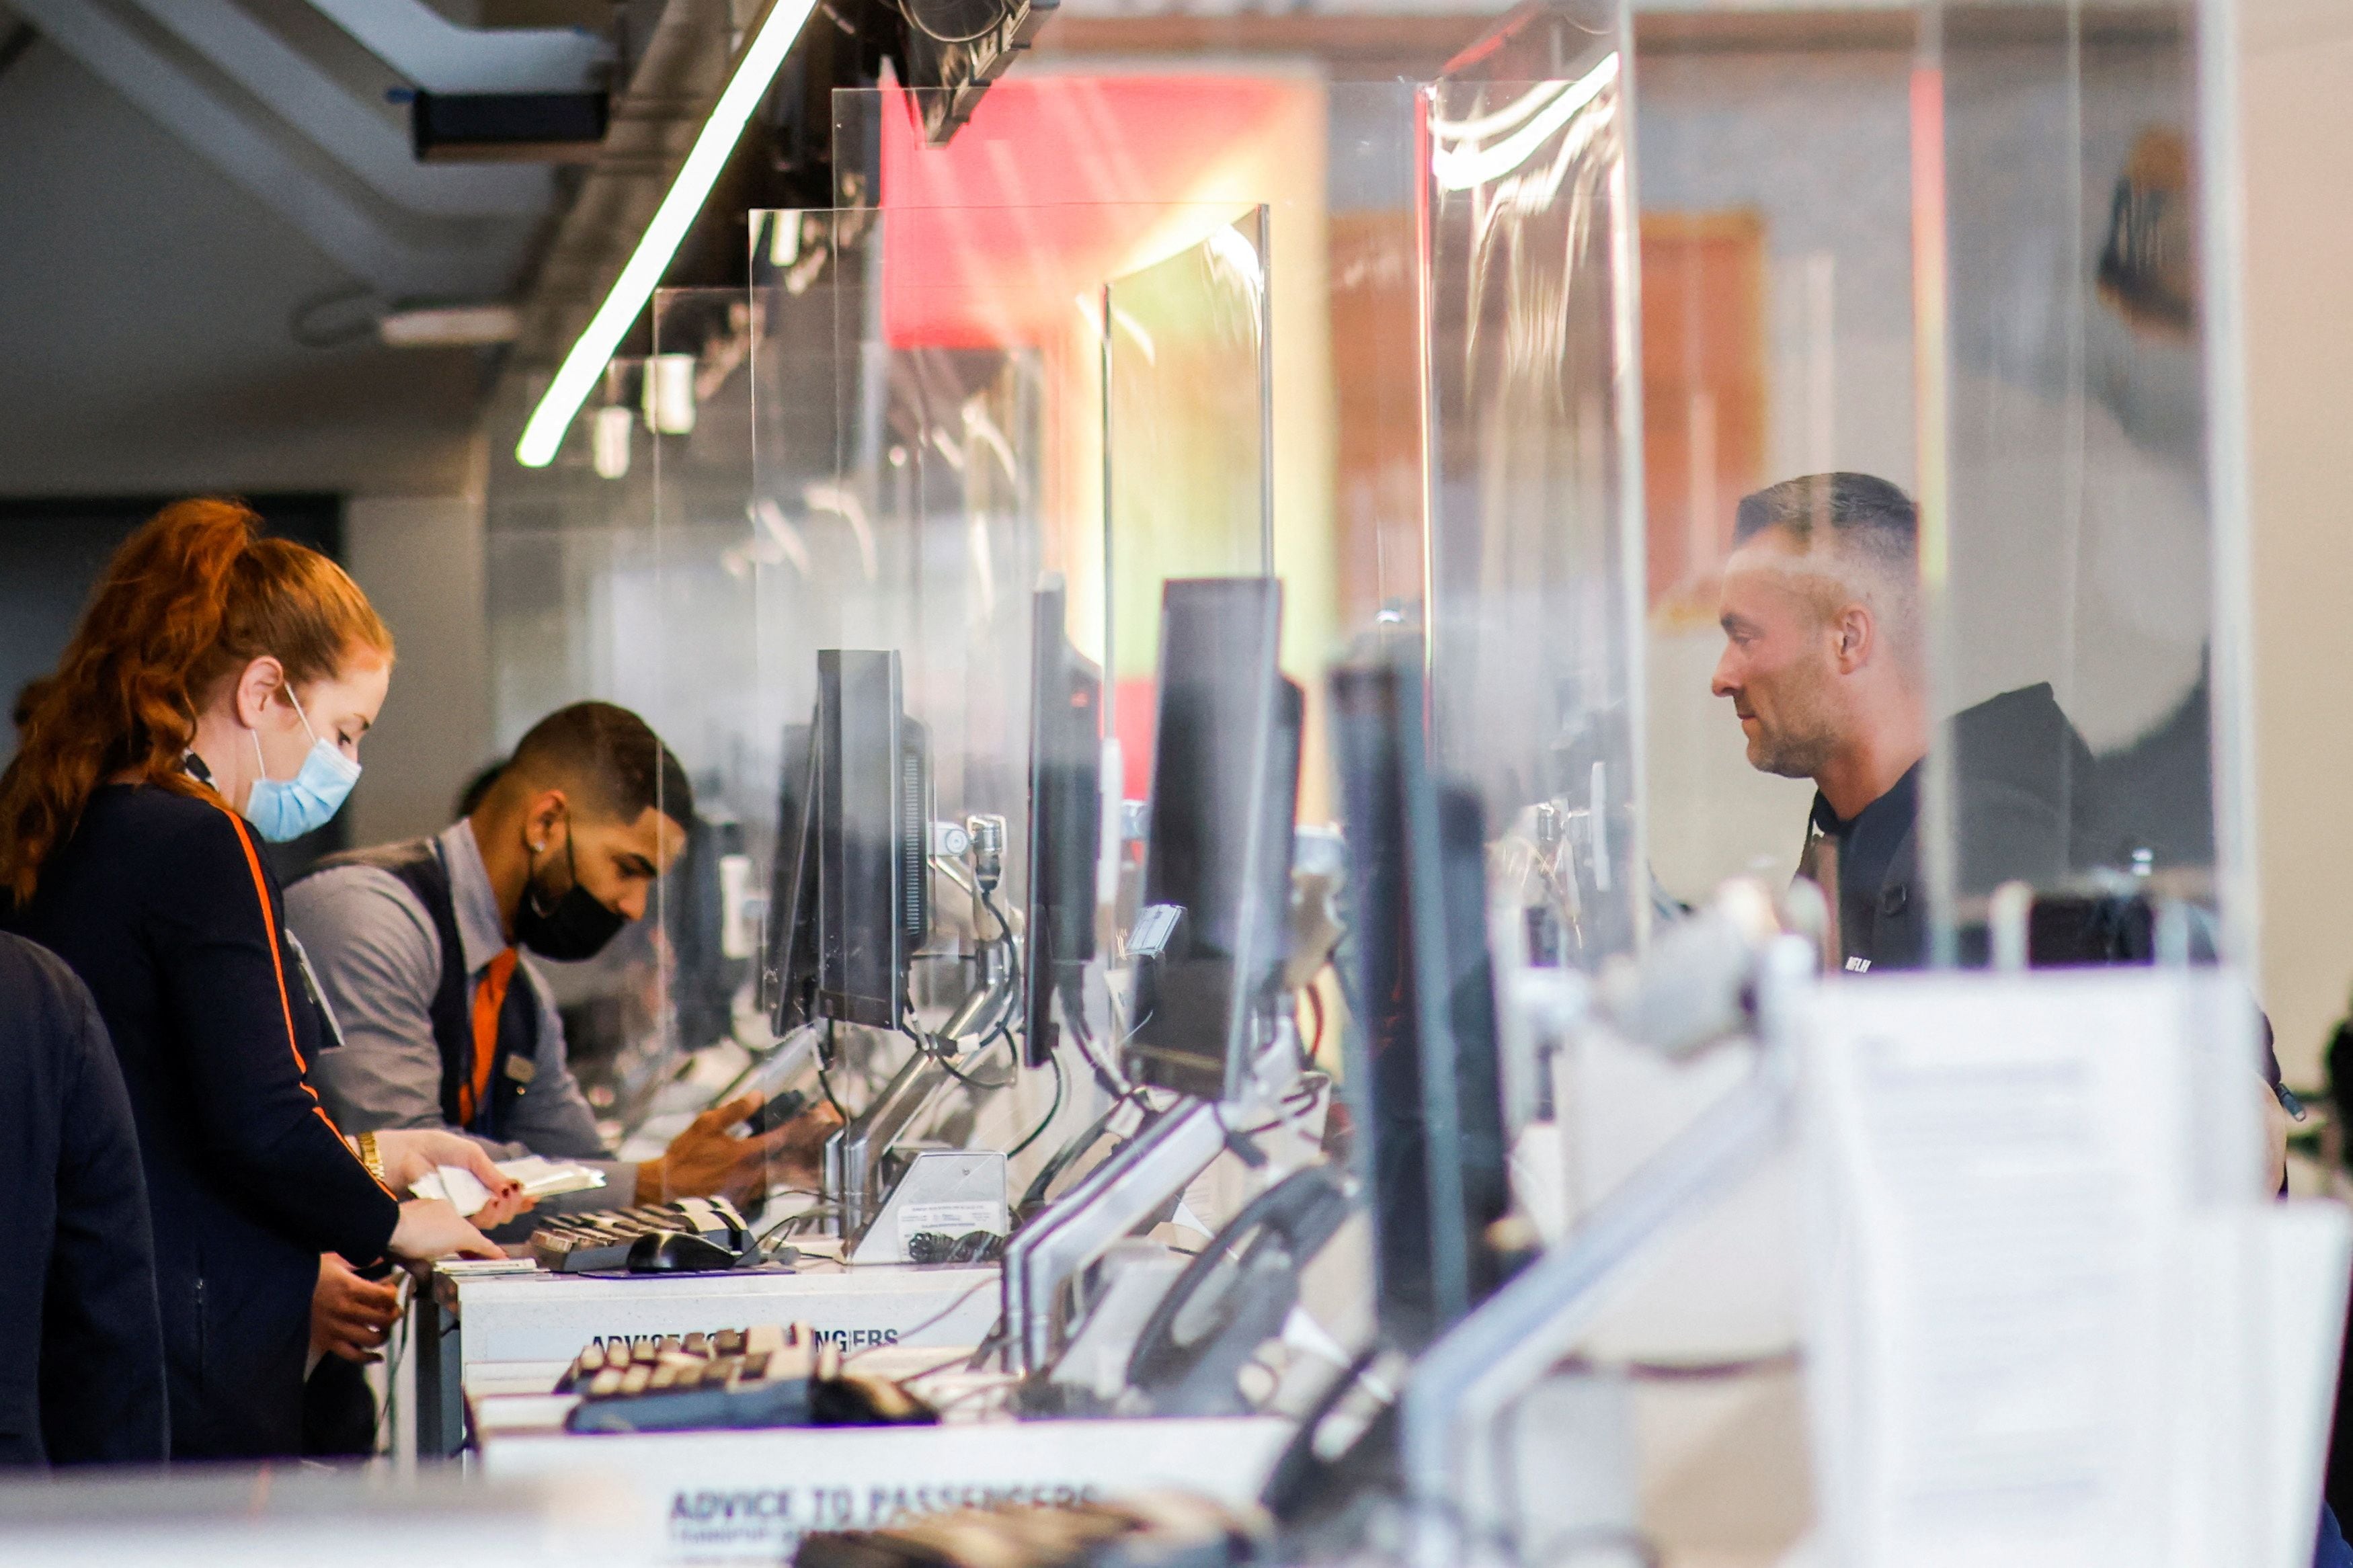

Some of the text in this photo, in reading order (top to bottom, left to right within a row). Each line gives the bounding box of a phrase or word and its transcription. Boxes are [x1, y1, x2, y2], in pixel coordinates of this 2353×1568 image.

[593, 1333, 680, 1352] ADV
[670, 1488, 789, 1520] ADVICE
[811, 1487, 852, 1524] TO
